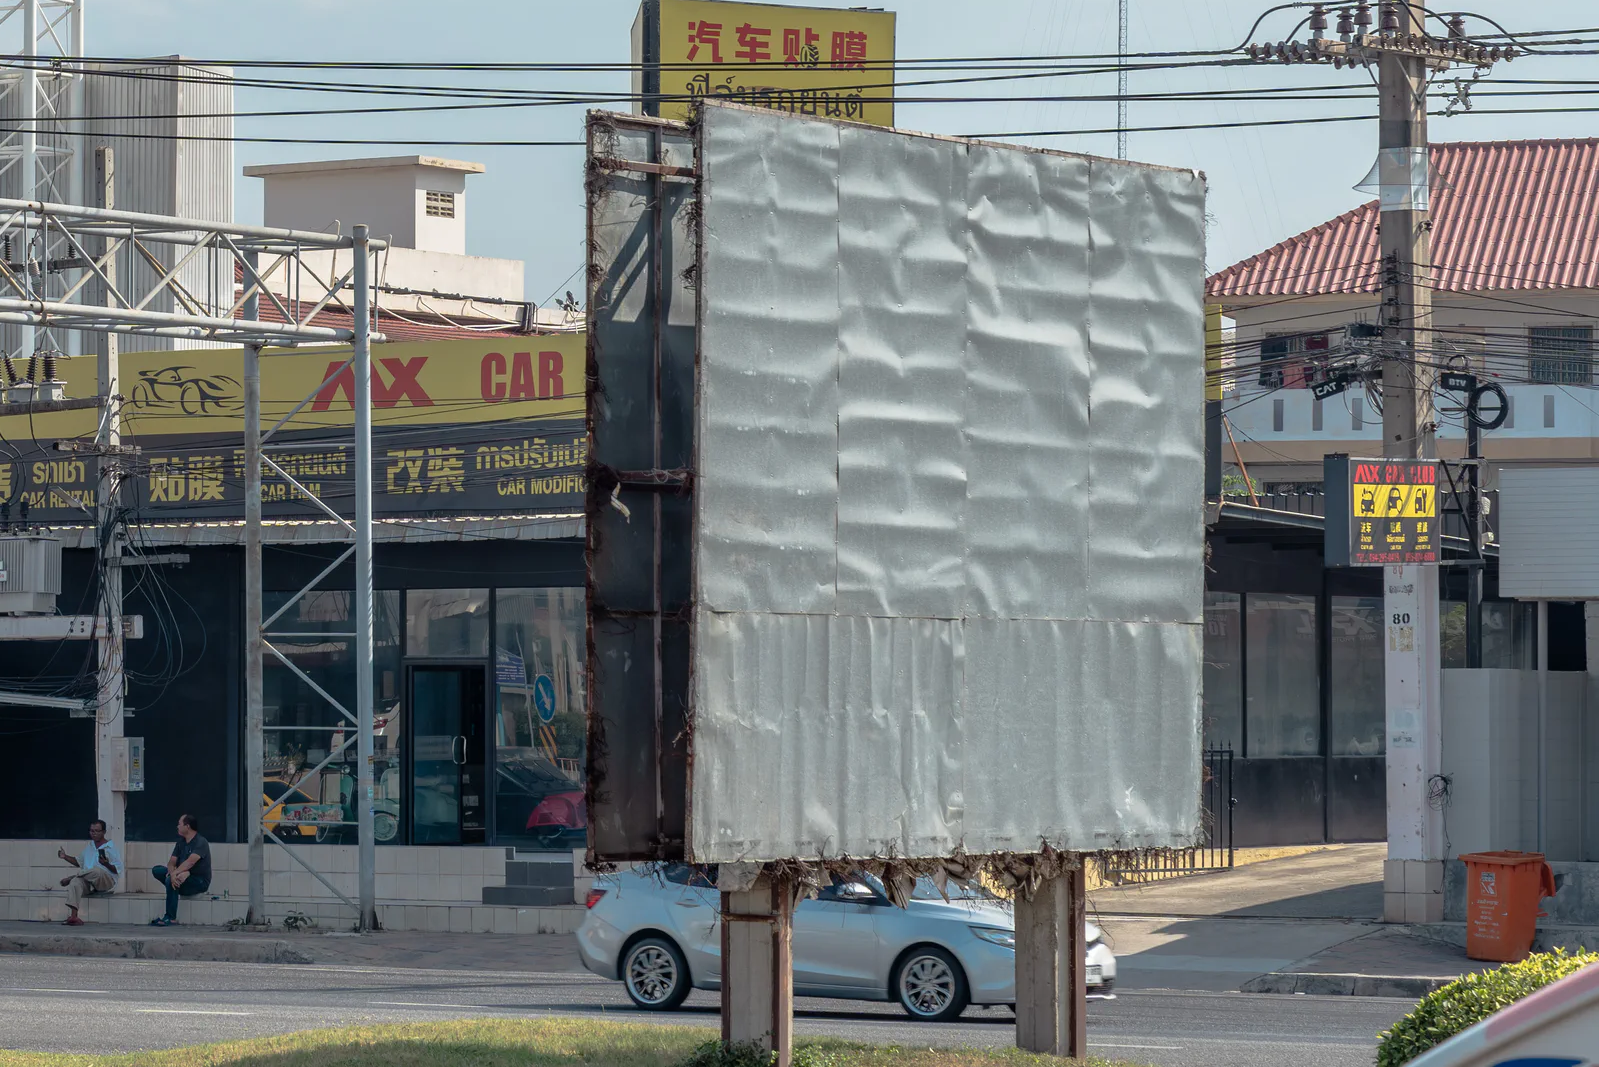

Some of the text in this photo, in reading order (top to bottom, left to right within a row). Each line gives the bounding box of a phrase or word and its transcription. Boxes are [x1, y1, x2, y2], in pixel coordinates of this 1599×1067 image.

[686, 20, 867, 73] 汽车贴膜
[481, 351, 564, 403] CAR
[1315, 382, 1337, 396] CAT
[260, 483, 320, 502] CAR FILM
[497, 477, 526, 495] CAR
[21, 491, 46, 509] CAR
[1392, 613, 1410, 625] 80
